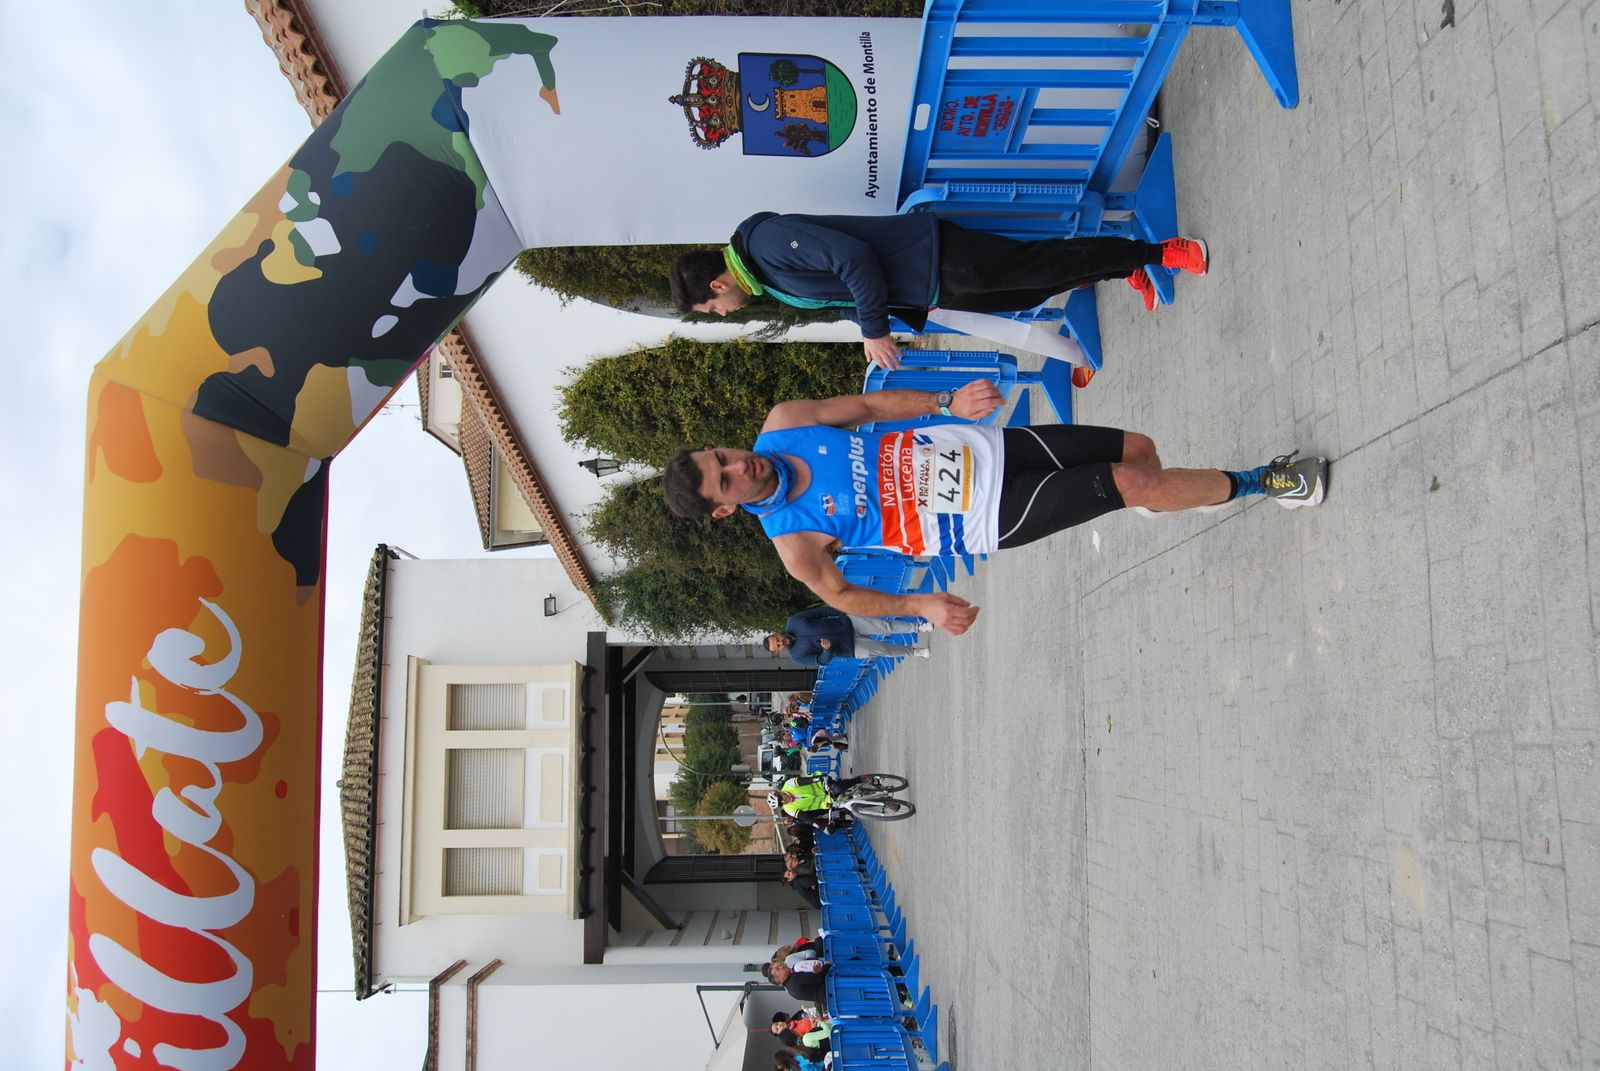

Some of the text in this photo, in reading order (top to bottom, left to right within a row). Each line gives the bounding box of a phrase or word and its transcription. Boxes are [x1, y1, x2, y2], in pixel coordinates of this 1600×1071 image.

[859, 31, 880, 199] Ayuntamiento de Montilla
[848, 435, 869, 519] enerplus
[879, 444, 897, 507] Maratón
[900, 447, 916, 502] Lucena
[917, 462, 928, 507] X BATALLA
[923, 486, 929, 497] DE
[937, 449, 961, 503] 424
